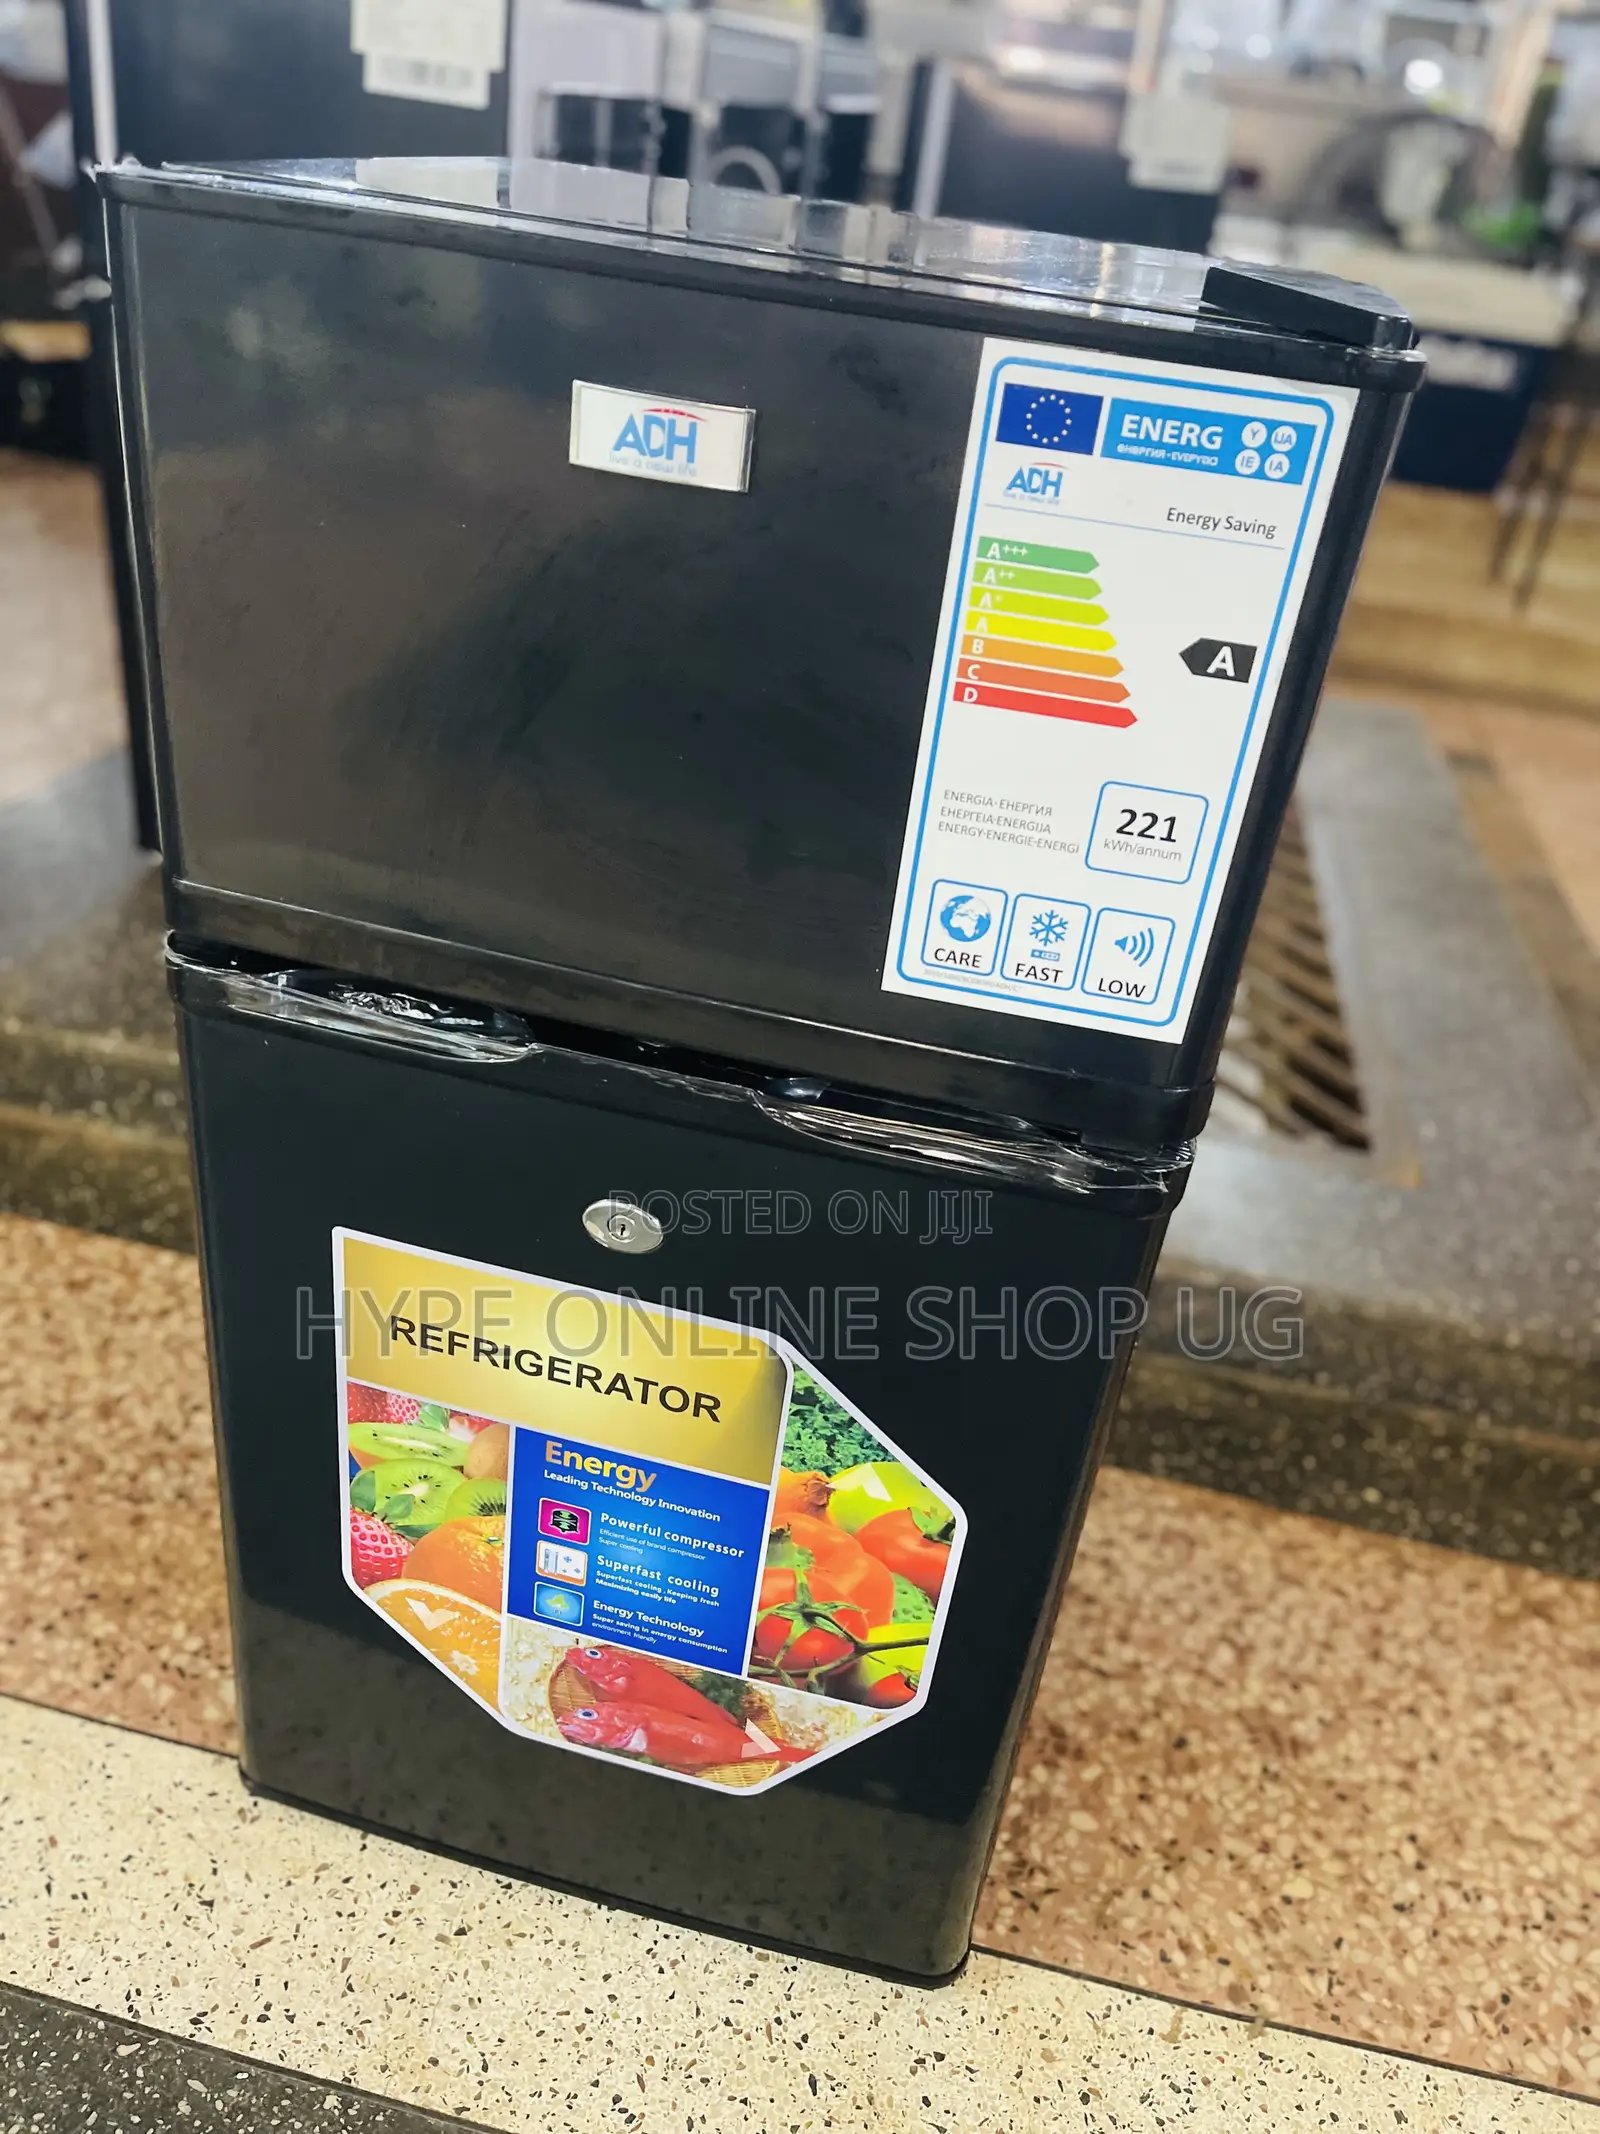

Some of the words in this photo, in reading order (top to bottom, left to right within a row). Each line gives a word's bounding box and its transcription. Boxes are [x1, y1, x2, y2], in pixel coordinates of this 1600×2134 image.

[613, 413, 697, 464] ADH
[1121, 414, 1223, 450] ENERG
[1250, 428, 1260, 441] Y
[1240, 455, 1255, 468] IE
[1268, 459, 1284, 472] IA
[1007, 467, 1063, 497] ADH
[1166, 507, 1222, 531] Energy
[1225, 516, 1277, 540] Saving
[986, 542, 1029, 560] A+++
[982, 567, 1016, 585] A++
[975, 616, 989, 633] A
[972, 638, 985, 655] B
[967, 663, 981, 680] C
[1206, 645, 1236, 677] A
[963, 687, 978, 703] D
[1115, 808, 1178, 843] 221
[1103, 838, 1183, 862] kWh/annum
[934, 947, 982, 969] CARE
[1014, 963, 1064, 984] FAST
[1097, 978, 1147, 998] LOW
[390, 1315, 722, 1423] REFRIGERATOR
[545, 1439, 657, 1493] Energy
[543, 1469, 588, 1490] Leading
[591, 1482, 656, 1507] Technology
[658, 1498, 721, 1522] Innovation
[598, 1536, 618, 1547] Super
[619, 1542, 644, 1555] cooling
[600, 1512, 661, 1537] Powerful
[664, 1530, 745, 1558] compressor
[667, 1547, 706, 1560] compressor
[597, 1555, 661, 1580] Superfast
[667, 1575, 719, 1597] cooling
[595, 1578, 639, 1596] Maximizing
[641, 1591, 663, 1601] easily
[663, 1595, 677, 1604] life
[596, 1570, 633, 1585] Superfast
[634, 1580, 662, 1593] cooling
[700, 1597, 720, 1607] fresh
[591, 1622, 632, 1637] environment
[593, 1599, 634, 1620] Energy
[636, 1611, 704, 1637] Technology
[592, 1613, 614, 1624] Super
[615, 1620, 640, 1632] saving
[650, 1630, 677, 1642] energy
[678, 1637, 728, 1654] consumption
